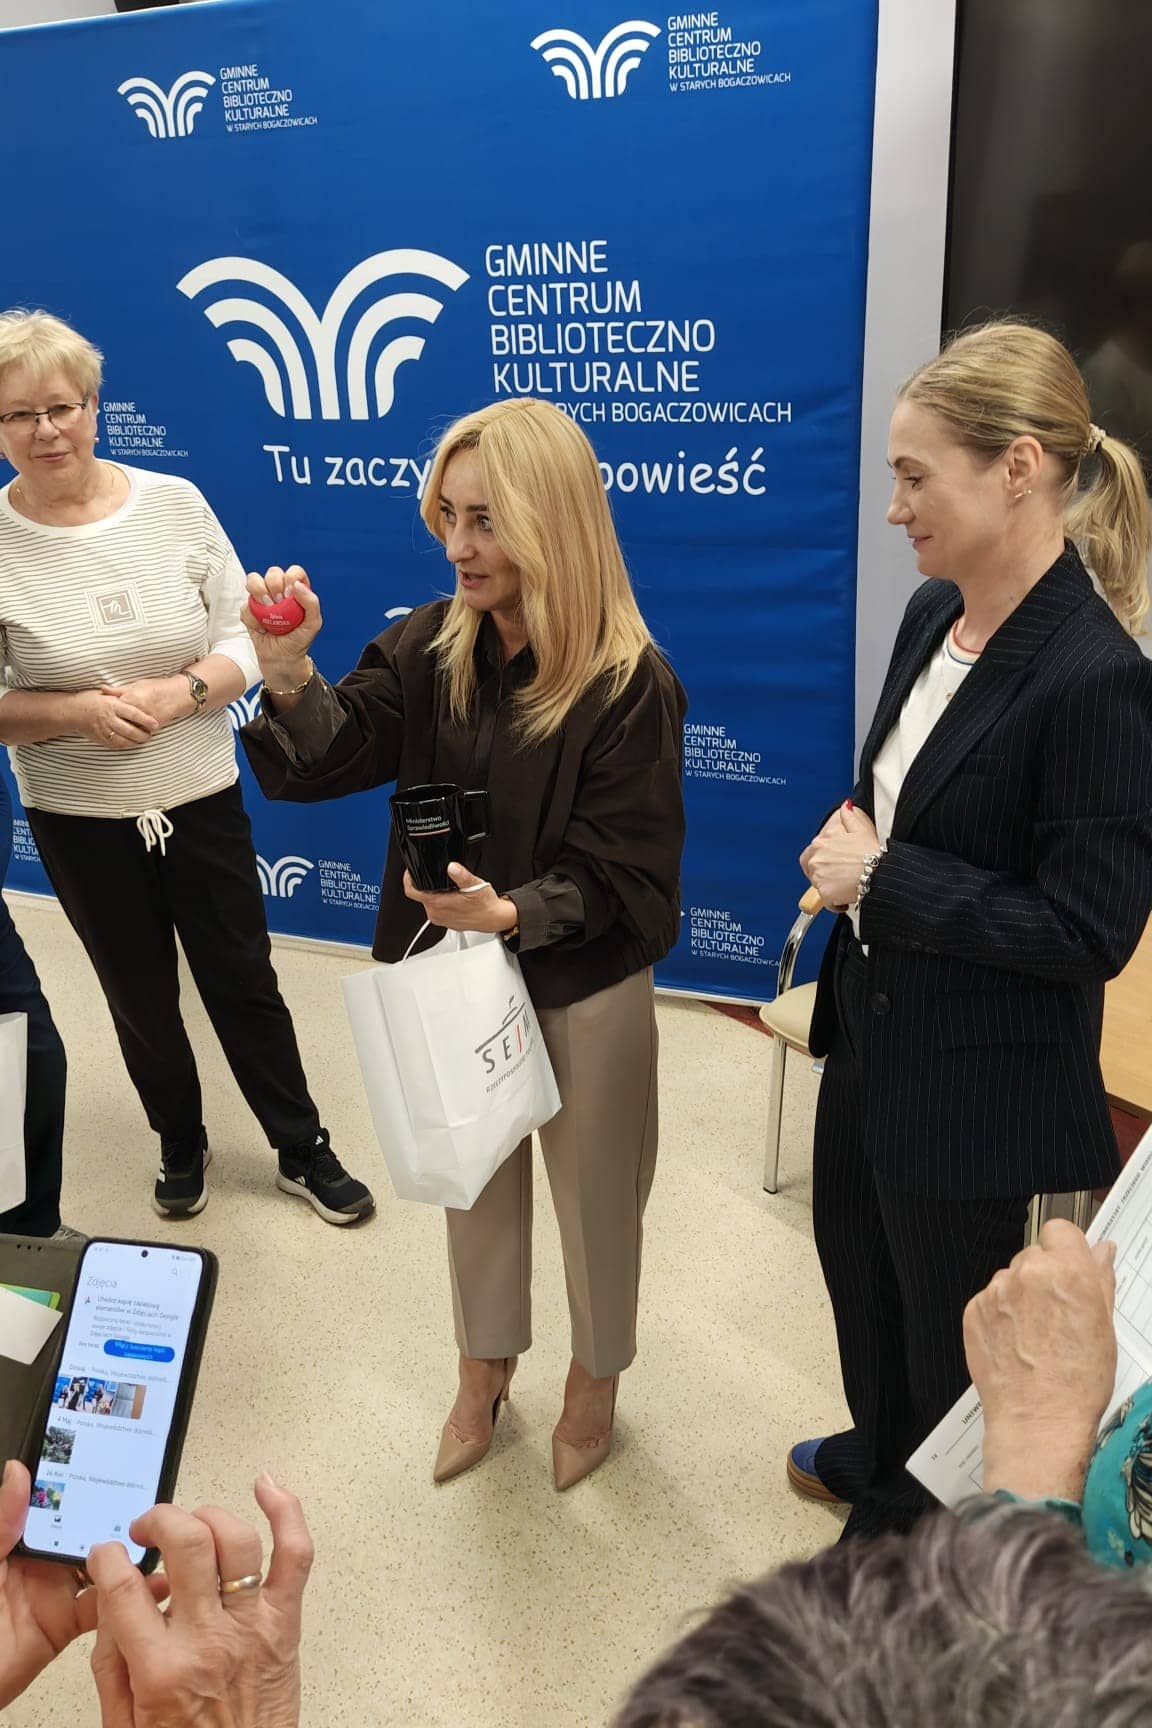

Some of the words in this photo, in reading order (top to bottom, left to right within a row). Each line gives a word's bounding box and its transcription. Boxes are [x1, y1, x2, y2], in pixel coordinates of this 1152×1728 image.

[668, 12, 718, 30] GMINNE
[668, 27, 732, 47] CENTRUM
[669, 41, 761, 63] BIBLIOTECZNO
[220, 64, 258, 80] GMINNE
[669, 59, 754, 80] KULTURALNE
[222, 78, 270, 94] CENTRUM
[670, 83, 678, 92] W
[680, 78, 716, 91] STARYCH
[718, 73, 790, 88] BOGACZOWICACH
[223, 89, 292, 108] BIBLIOTECZNO
[225, 104, 290, 122] KULTURALNE
[227, 124, 234, 132] W
[235, 119, 262, 132] STARYCH
[263, 116, 318, 129] BOGACZOWICACH
[485, 240, 608, 277] GMINNE
[488, 280, 641, 316] CENTRUM
[491, 319, 715, 355] BIBLIOTECZNO
[494, 361, 700, 393] KULTURALNE
[104, 402, 136, 412] GMINNE
[612, 402, 792, 423] BOGACZOWICACH
[105, 414, 146, 424] CENTRUM
[107, 425, 166, 436] BIBLIOTECZNO
[109, 437, 164, 448] KULTURALNE
[263, 444, 311, 486] Tu
[325, 457, 432, 500] zaczy
[684, 724, 726, 737] GMINNE
[684, 735, 737, 749] CENTRUM
[684, 747, 760, 762] BIBLIOTECZNO
[685, 758, 756, 774] KULTURALNE
[694, 770, 725, 780] STARYCH
[726, 773, 786, 785] BOGACZOWICACH
[319, 860, 351, 872] GMINNE
[320, 869, 361, 882] CENTRUM
[321, 879, 380, 894] BIBLIOTECZNO
[322, 888, 376, 904] KULTURALNE
[354, 902, 379, 911] BOGACZO
[690, 907, 731, 920] GMINNE
[691, 918, 742, 932] CENTRUM
[691, 928, 764, 946] BIBLIOTECZNO
[691, 938, 760, 956] KULTURALNE
[700, 950, 729, 960] STARYCH
[730, 954, 781, 967] BOGACZOWICA
